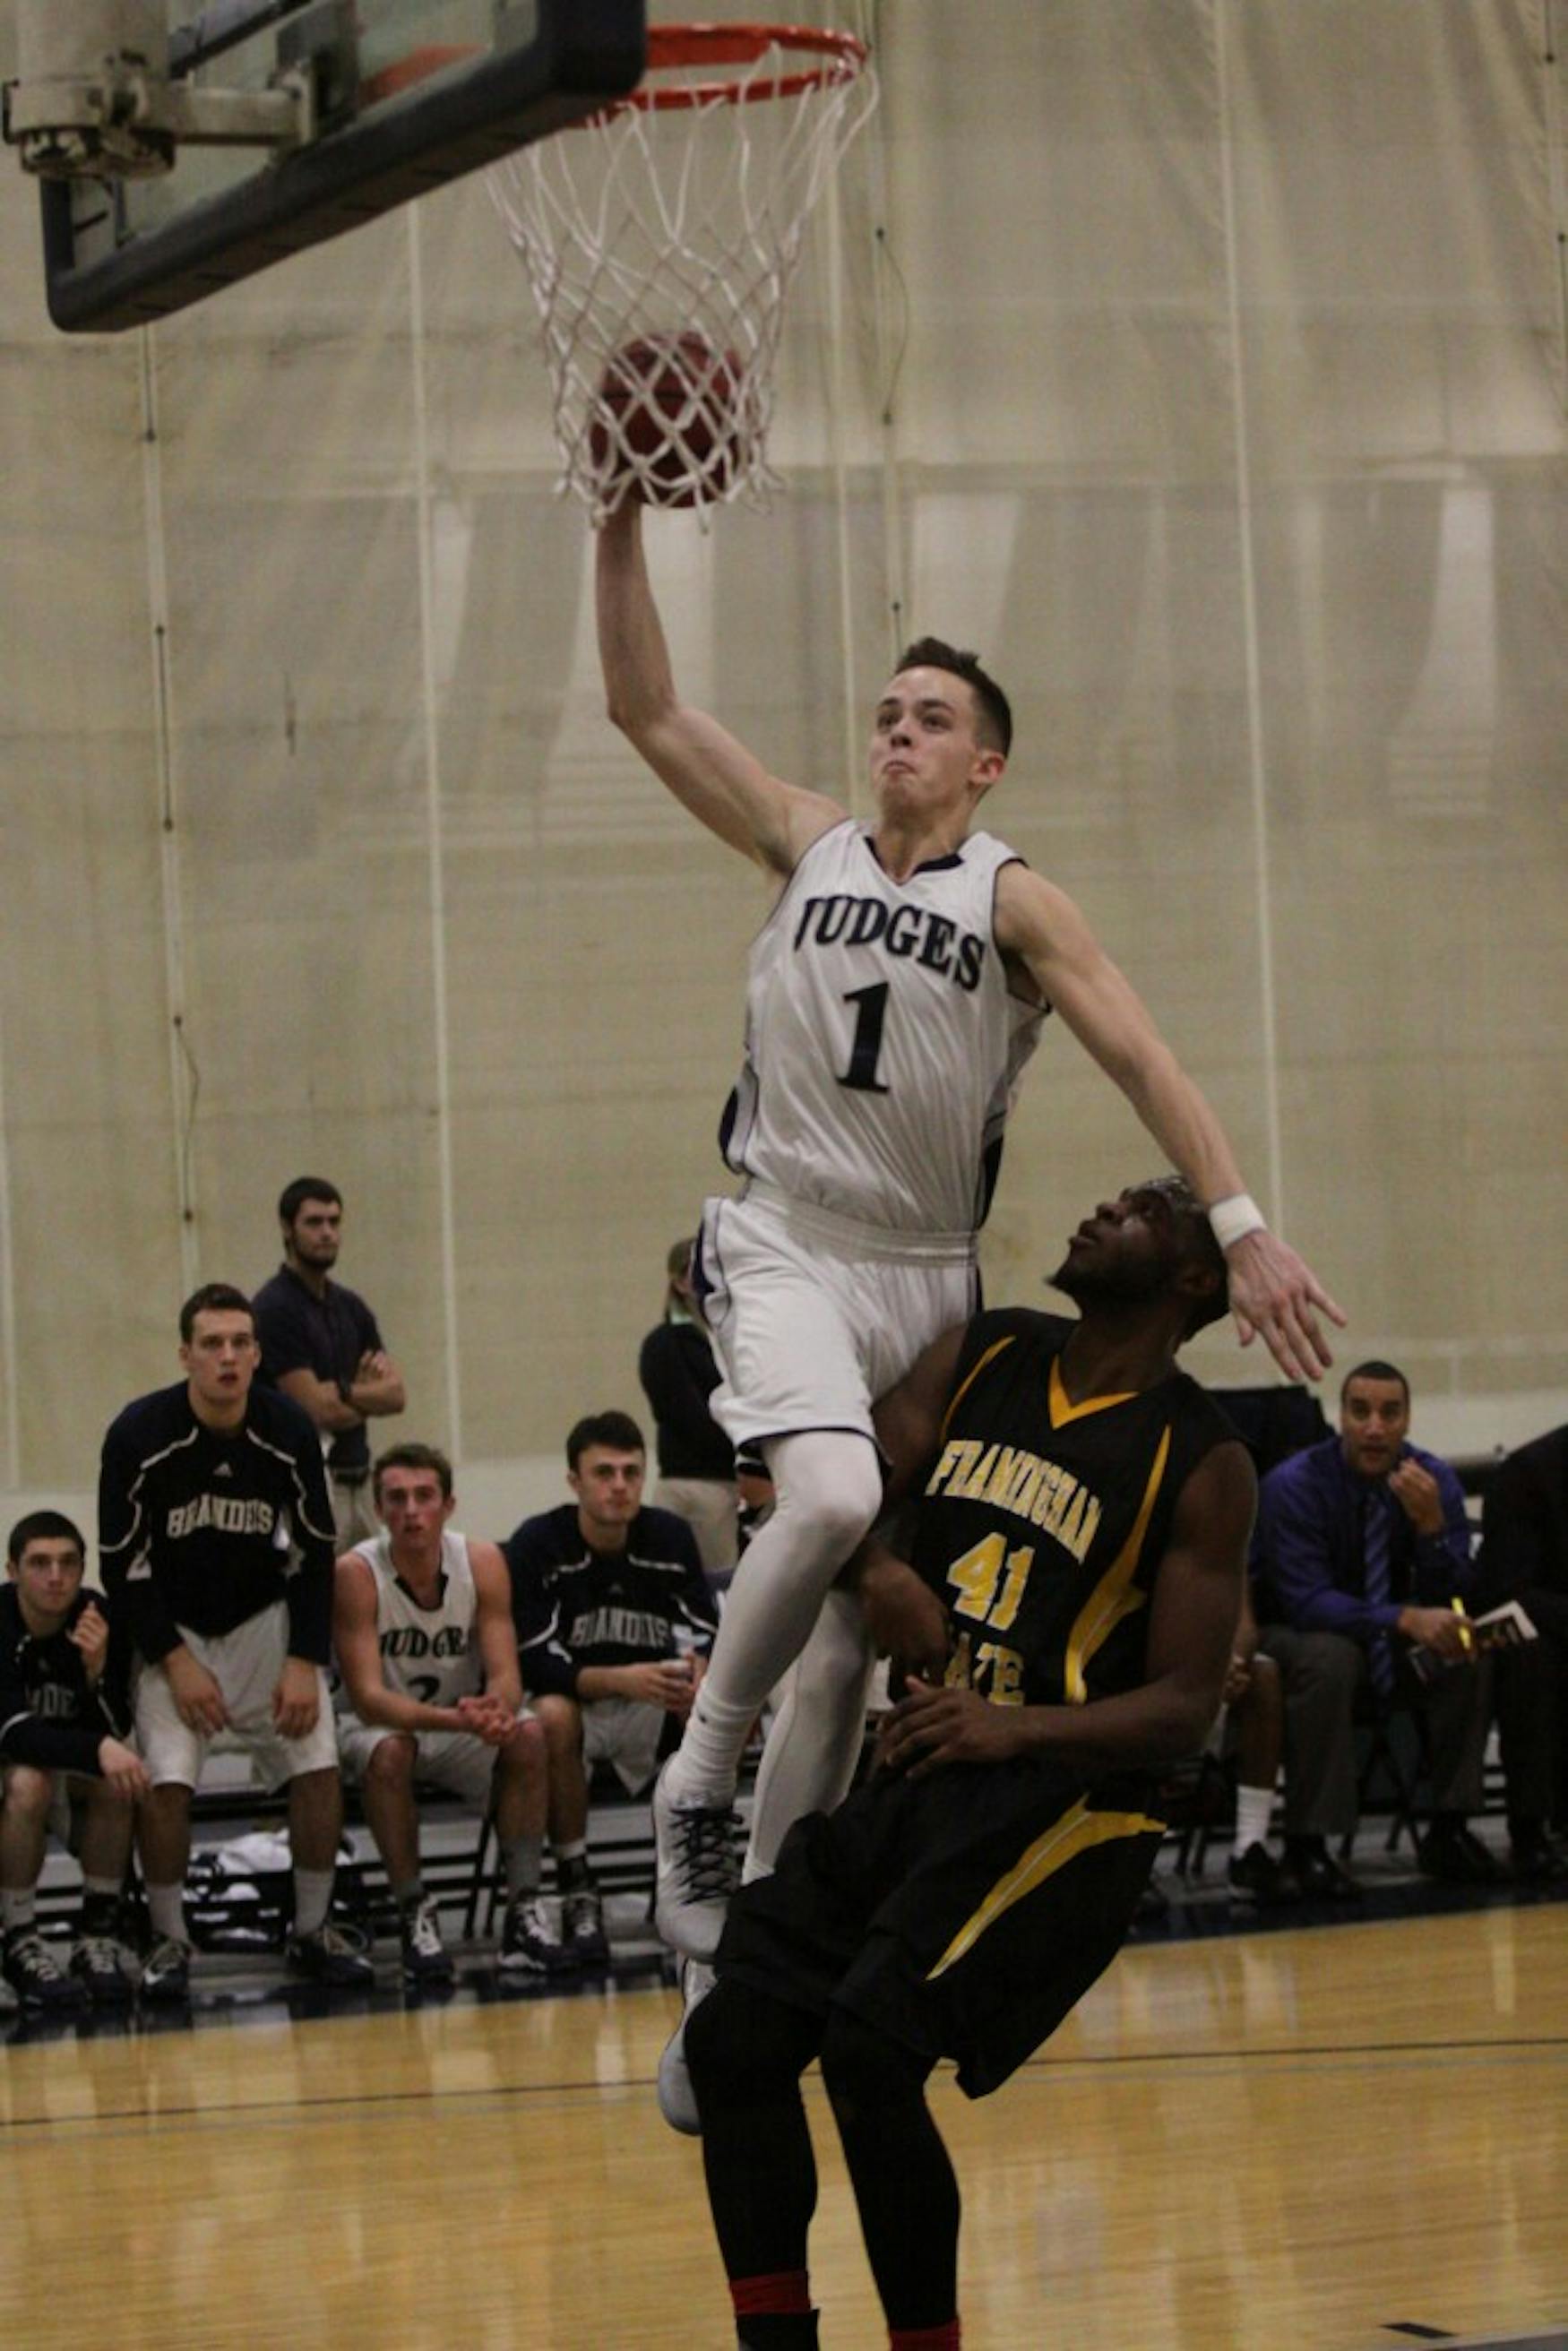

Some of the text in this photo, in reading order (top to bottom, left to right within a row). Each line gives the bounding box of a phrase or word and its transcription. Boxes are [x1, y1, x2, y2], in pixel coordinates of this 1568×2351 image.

[793, 894, 986, 992] JUDGES
[835, 981, 890, 1093] 1
[946, 1531, 1035, 1631] 41
